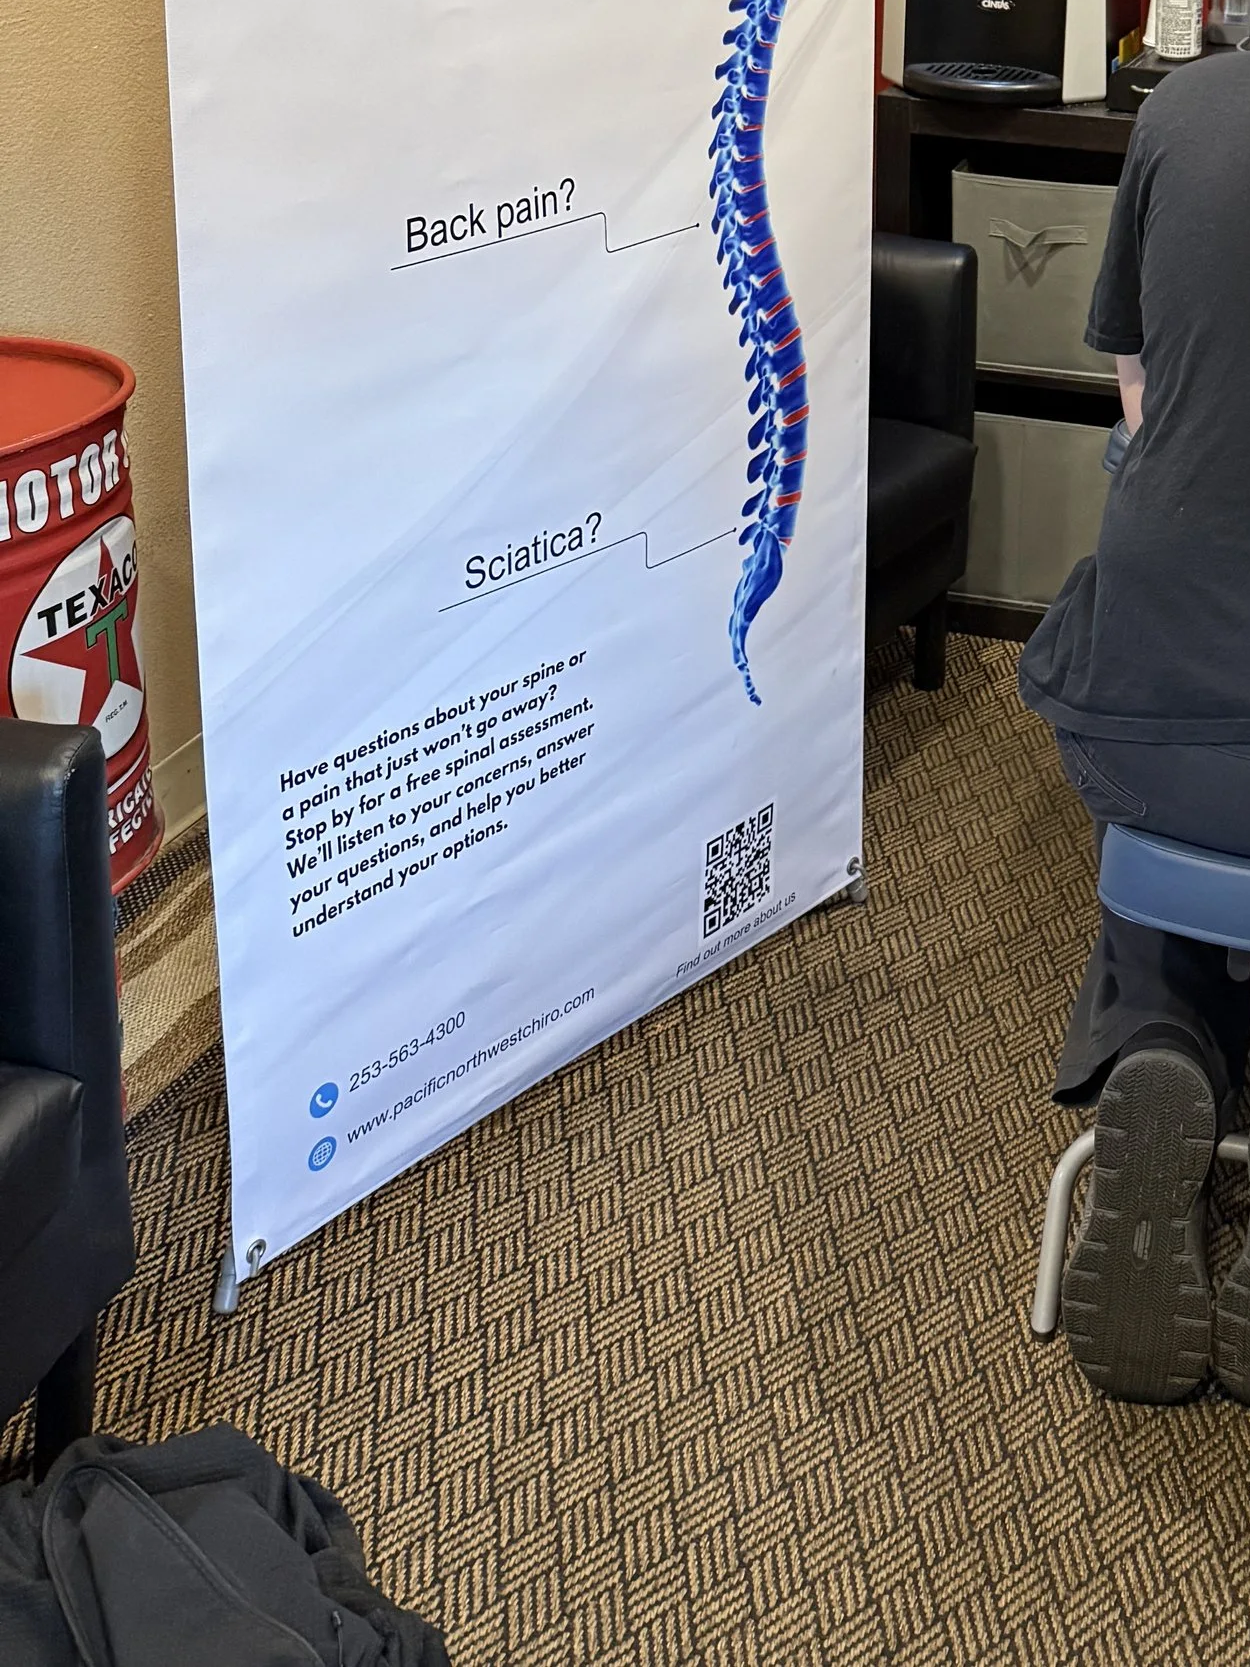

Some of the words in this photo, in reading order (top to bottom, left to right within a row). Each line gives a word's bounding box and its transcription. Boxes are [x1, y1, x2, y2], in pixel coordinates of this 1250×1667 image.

[406, 203, 487, 253] Back
[496, 178, 576, 239] pain?
[0, 429, 120, 542] OTOR
[37, 540, 138, 638] TEXACO
[464, 512, 602, 589] Sciatica?
[280, 762, 328, 793] Have
[334, 722, 420, 771] questions
[424, 696, 475, 730] about
[479, 680, 519, 712] your
[522, 661, 565, 689] spine
[569, 650, 587, 667] or
[282, 806, 294, 821] a
[300, 784, 340, 819] pain
[345, 763, 383, 792] that
[385, 748, 419, 780] just
[422, 723, 472, 756] won't
[476, 717, 497, 738] go
[502, 684, 557, 722] away?
[286, 821, 327, 850] Stop
[331, 806, 355, 828] by
[359, 792, 385, 814] for
[390, 786, 401, 800] a
[406, 769, 441, 793] free
[445, 737, 495, 777] spinal
[499, 697, 593, 750] assessment.
[286, 840, 332, 879] We'll
[337, 823, 384, 855] listen
[388, 813, 406, 829] to
[410, 791, 452, 824] your
[456, 755, 532, 798] concerns,
[536, 723, 595, 759] answer
[289, 877, 332, 915] your
[337, 834, 425, 887] questions,
[430, 807, 462, 837] and
[467, 793, 502, 820] help
[505, 778, 535, 806] you
[540, 752, 586, 785] better
[293, 868, 394, 937] understand
[398, 852, 438, 888] your
[443, 820, 508, 859] options.
[676, 952, 701, 978] Find
[703, 941, 721, 960] out
[723, 923, 751, 948] more
[753, 901, 782, 927] about
[784, 892, 796, 906] us
[347, 987, 595, 1144] www.pacificnorthwestchiro.com
[349, 1011, 465, 1092] 253-563-4300
